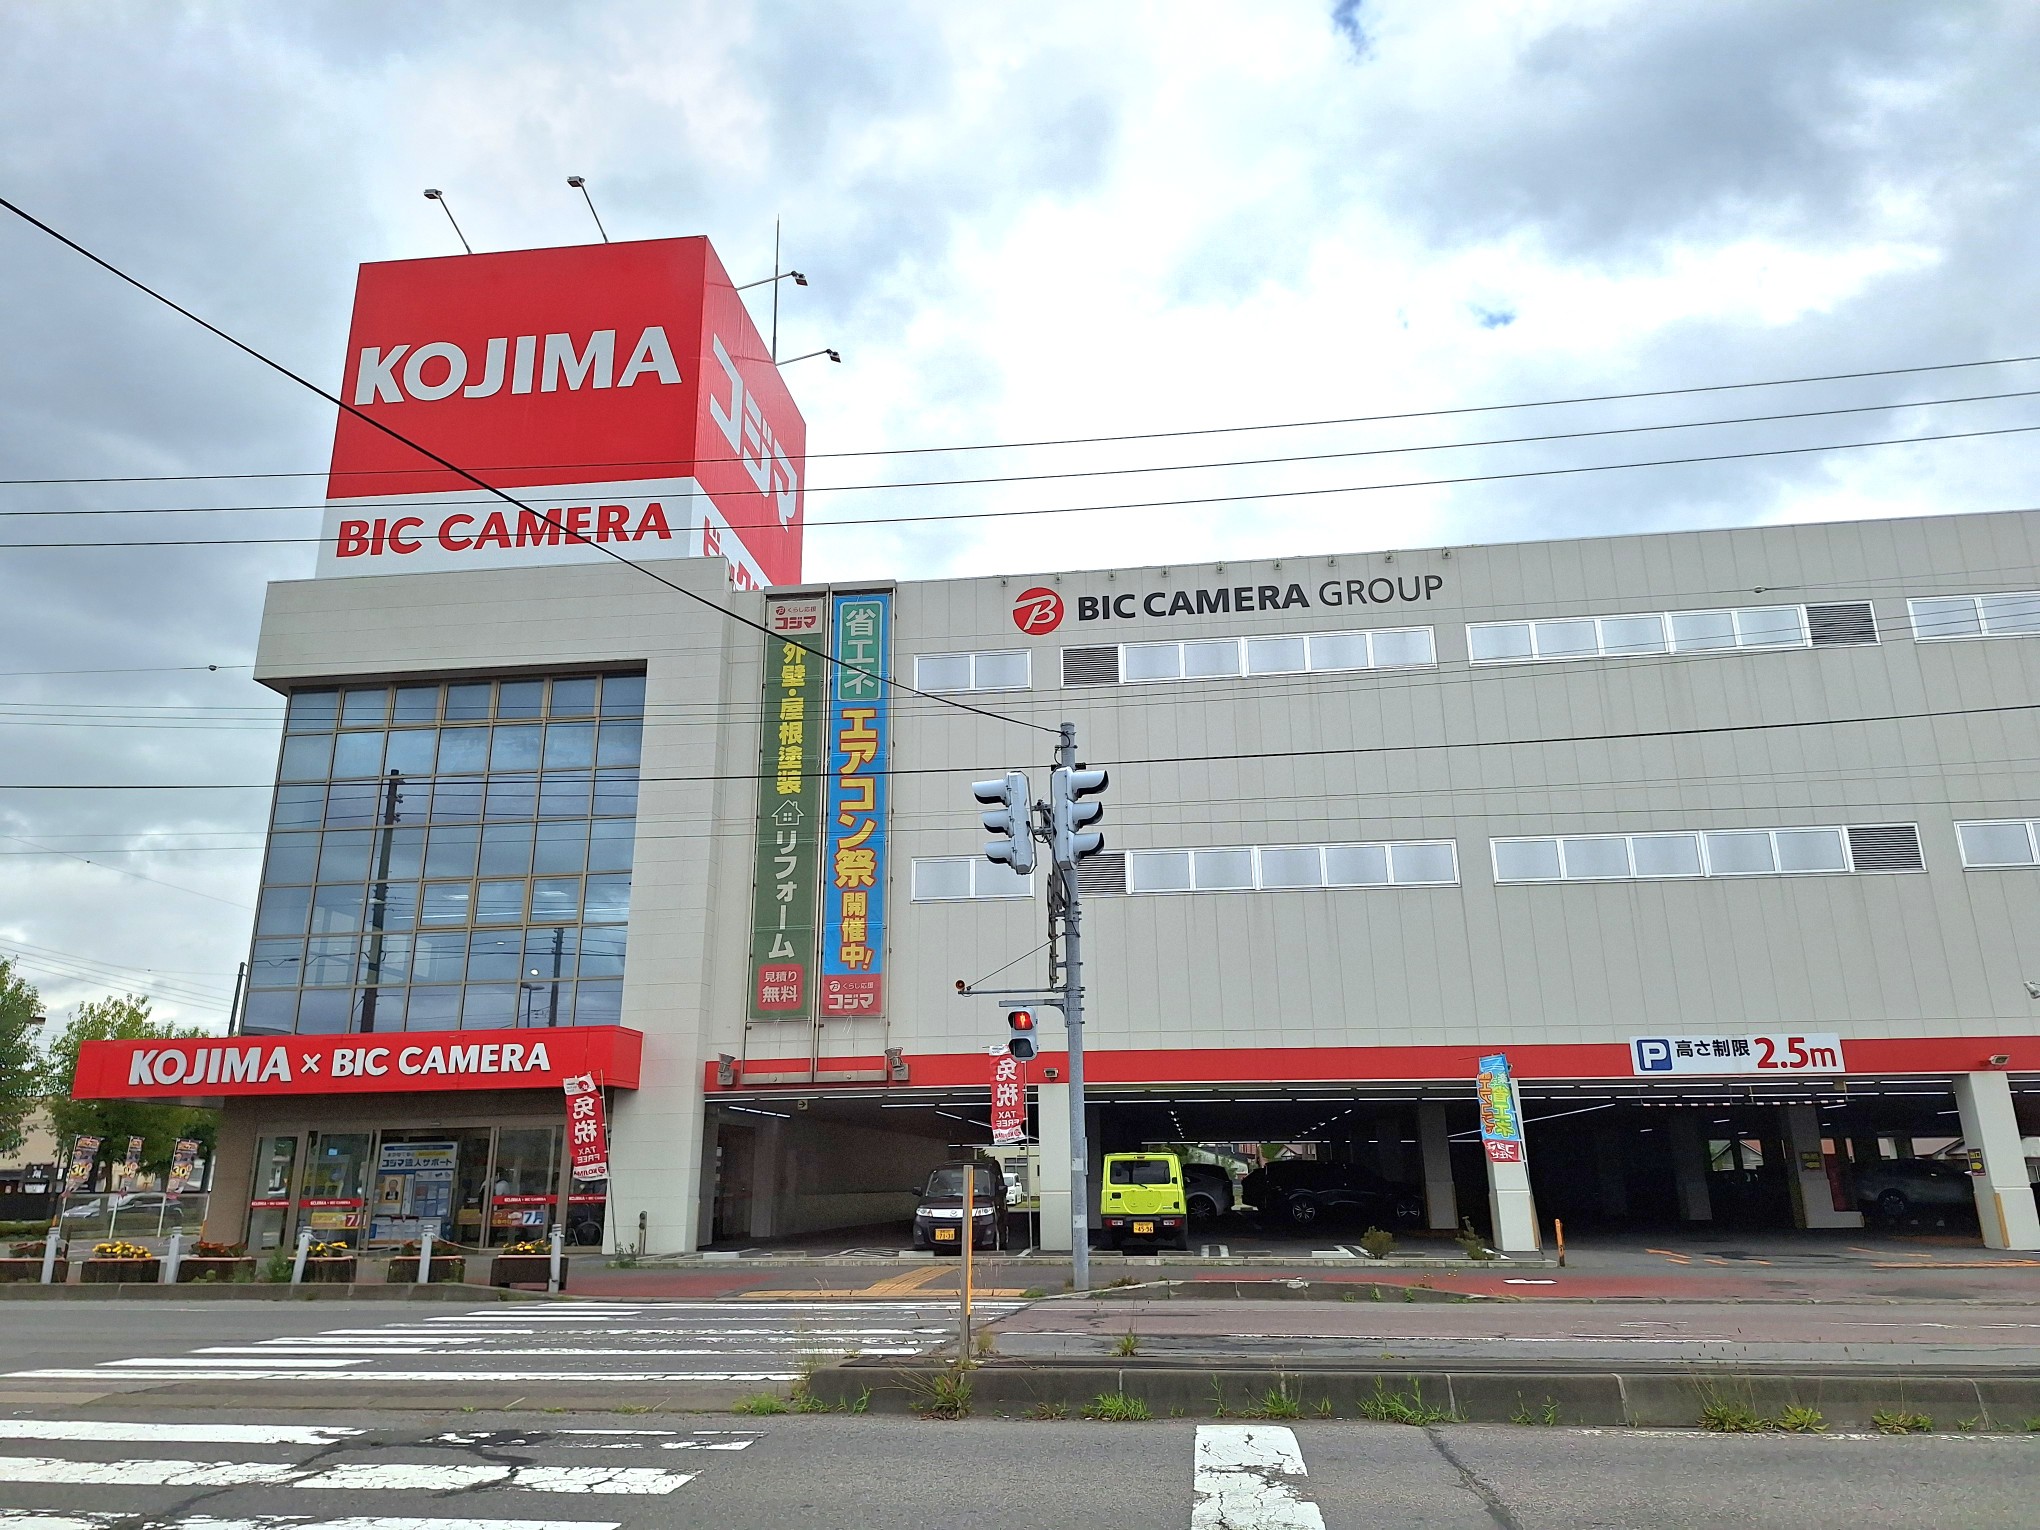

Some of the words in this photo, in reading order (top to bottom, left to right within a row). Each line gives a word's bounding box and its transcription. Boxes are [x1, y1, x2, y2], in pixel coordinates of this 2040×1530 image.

[354, 326, 682, 406] KOJIMA
[710, 332, 797, 533] コジマ
[336, 516, 424, 558] BIC
[438, 502, 672, 552] CAMERA
[1077, 593, 1136, 622] BIC
[1143, 583, 1310, 618] CAMERA
[1318, 574, 1444, 607] GROUP
[775, 616, 816, 629] コジマ
[844, 608, 876, 695] 省エネ
[768, 830, 797, 959] リフォーム
[762, 985, 797, 1003] 無料
[764, 971, 797, 983] 見積り
[828, 993, 874, 1009] コジマ
[128, 1046, 292, 1085] KOJIMA
[331, 1047, 390, 1077] BIC
[398, 1042, 551, 1075] CAMERA
[1674, 1039, 1750, 1058] 高さ制限
[1754, 1037, 1837, 1069] 2.5m
